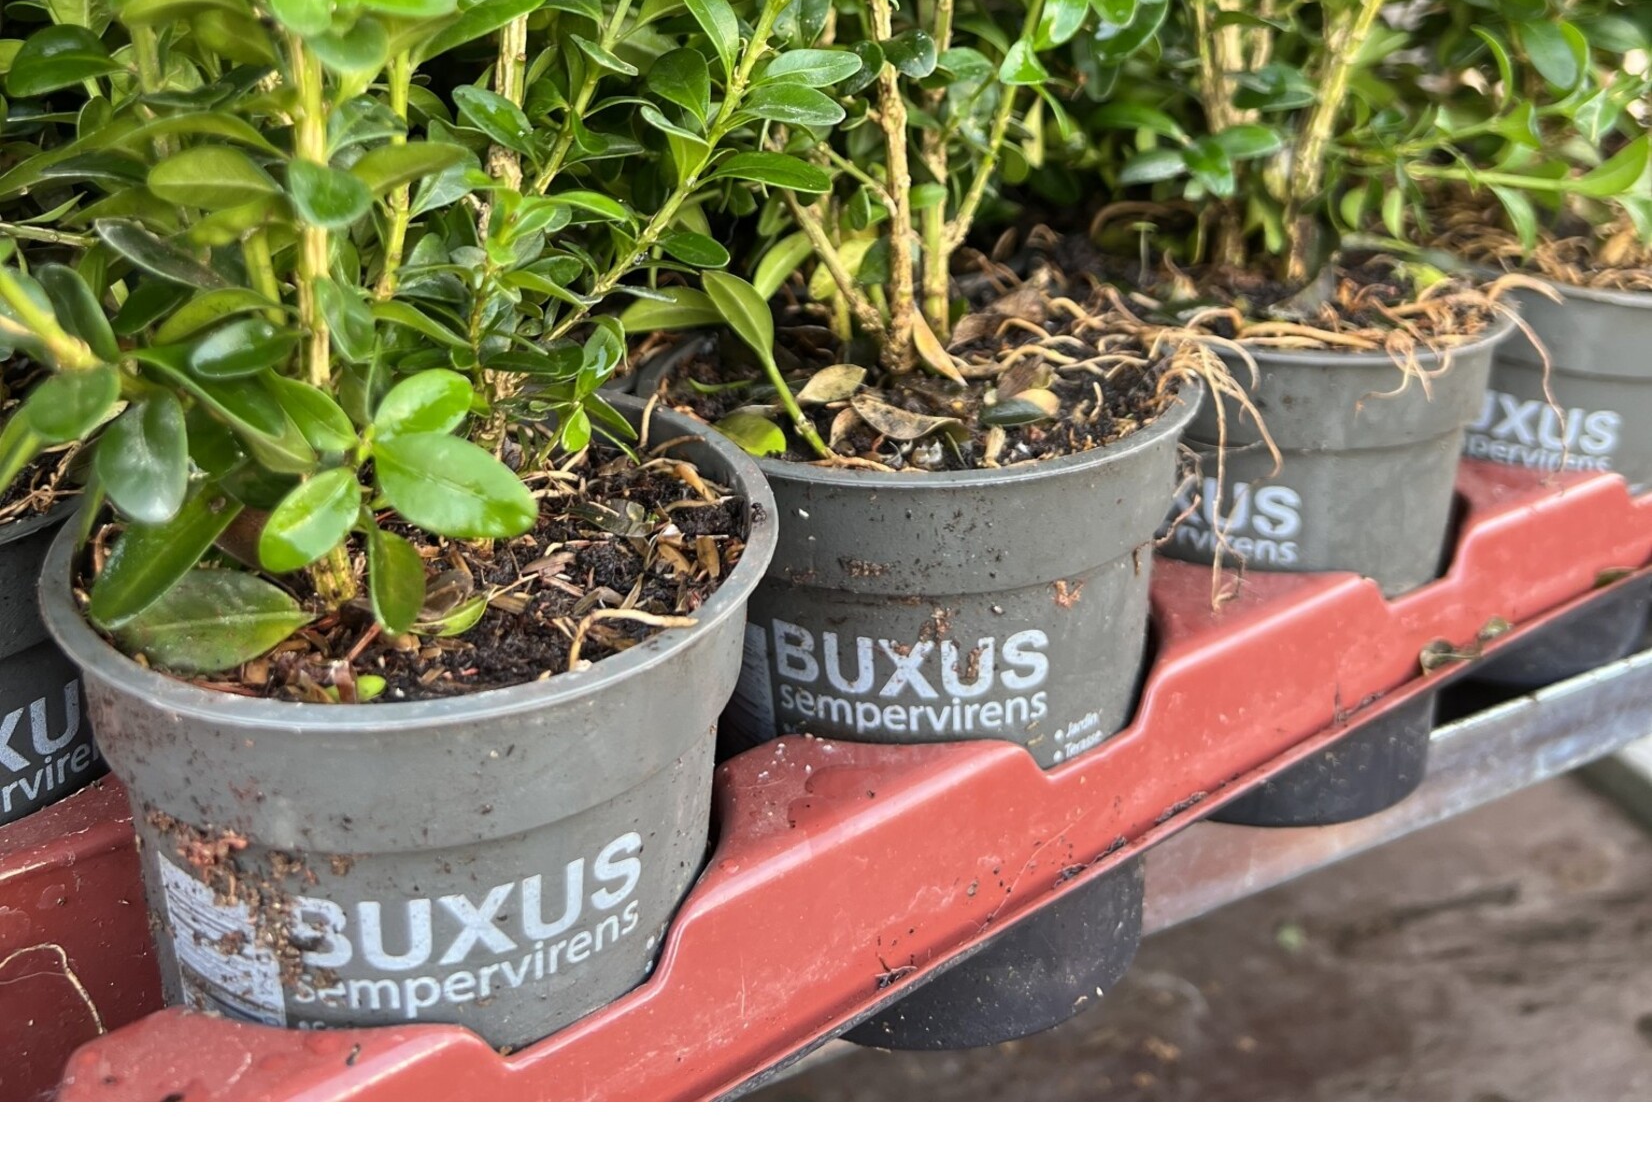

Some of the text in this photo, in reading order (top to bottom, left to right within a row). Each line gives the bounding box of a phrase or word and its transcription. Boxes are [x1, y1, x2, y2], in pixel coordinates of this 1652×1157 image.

[772, 617, 1050, 700] BUXUS
[780, 683, 1048, 734] sempervirens
[293, 831, 643, 971] BUXUS
[294, 899, 640, 1018] sempervirens
